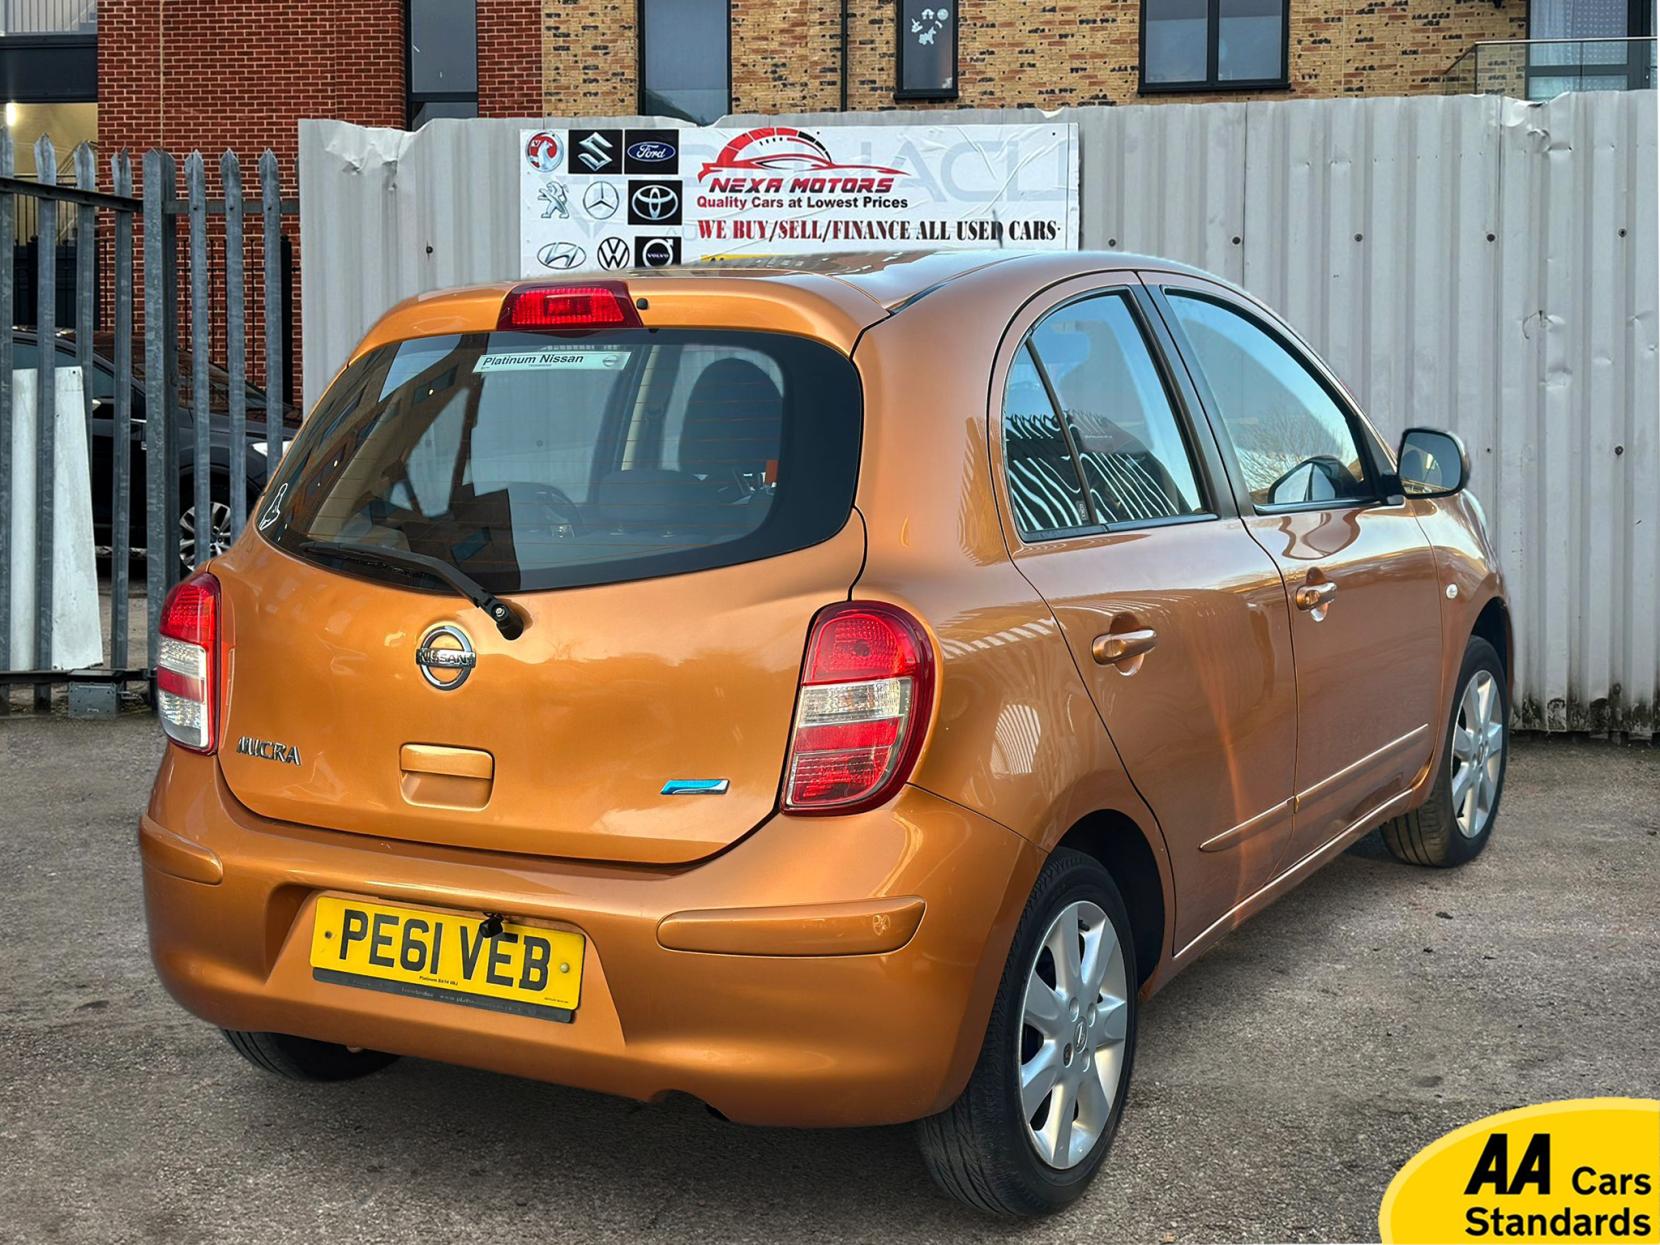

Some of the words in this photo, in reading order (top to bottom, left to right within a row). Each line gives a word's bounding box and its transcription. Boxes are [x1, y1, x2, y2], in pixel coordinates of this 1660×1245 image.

[636, 143, 666, 158] Ford
[709, 178, 784, 193] NEXA
[789, 178, 895, 193] MOTORS
[697, 196, 747, 210] Quality
[751, 196, 784, 208] Cars
[788, 197, 803, 208] at
[807, 196, 858, 208] Lowest
[863, 196, 908, 208] Prices
[697, 220, 727, 240] WE
[733, 219, 911, 243] BUY/SELL/FINANCE
[916, 220, 951, 240] ALL
[956, 220, 1004, 240] USED
[1008, 220, 1057, 240] CARS
[482, 355, 536, 366] Platinum
[539, 354, 584, 364] Nissan
[418, 647, 471, 666] NISSAN
[236, 736, 302, 766] MICRA
[339, 908, 443, 975] PE61
[460, 926, 551, 992] VEB
